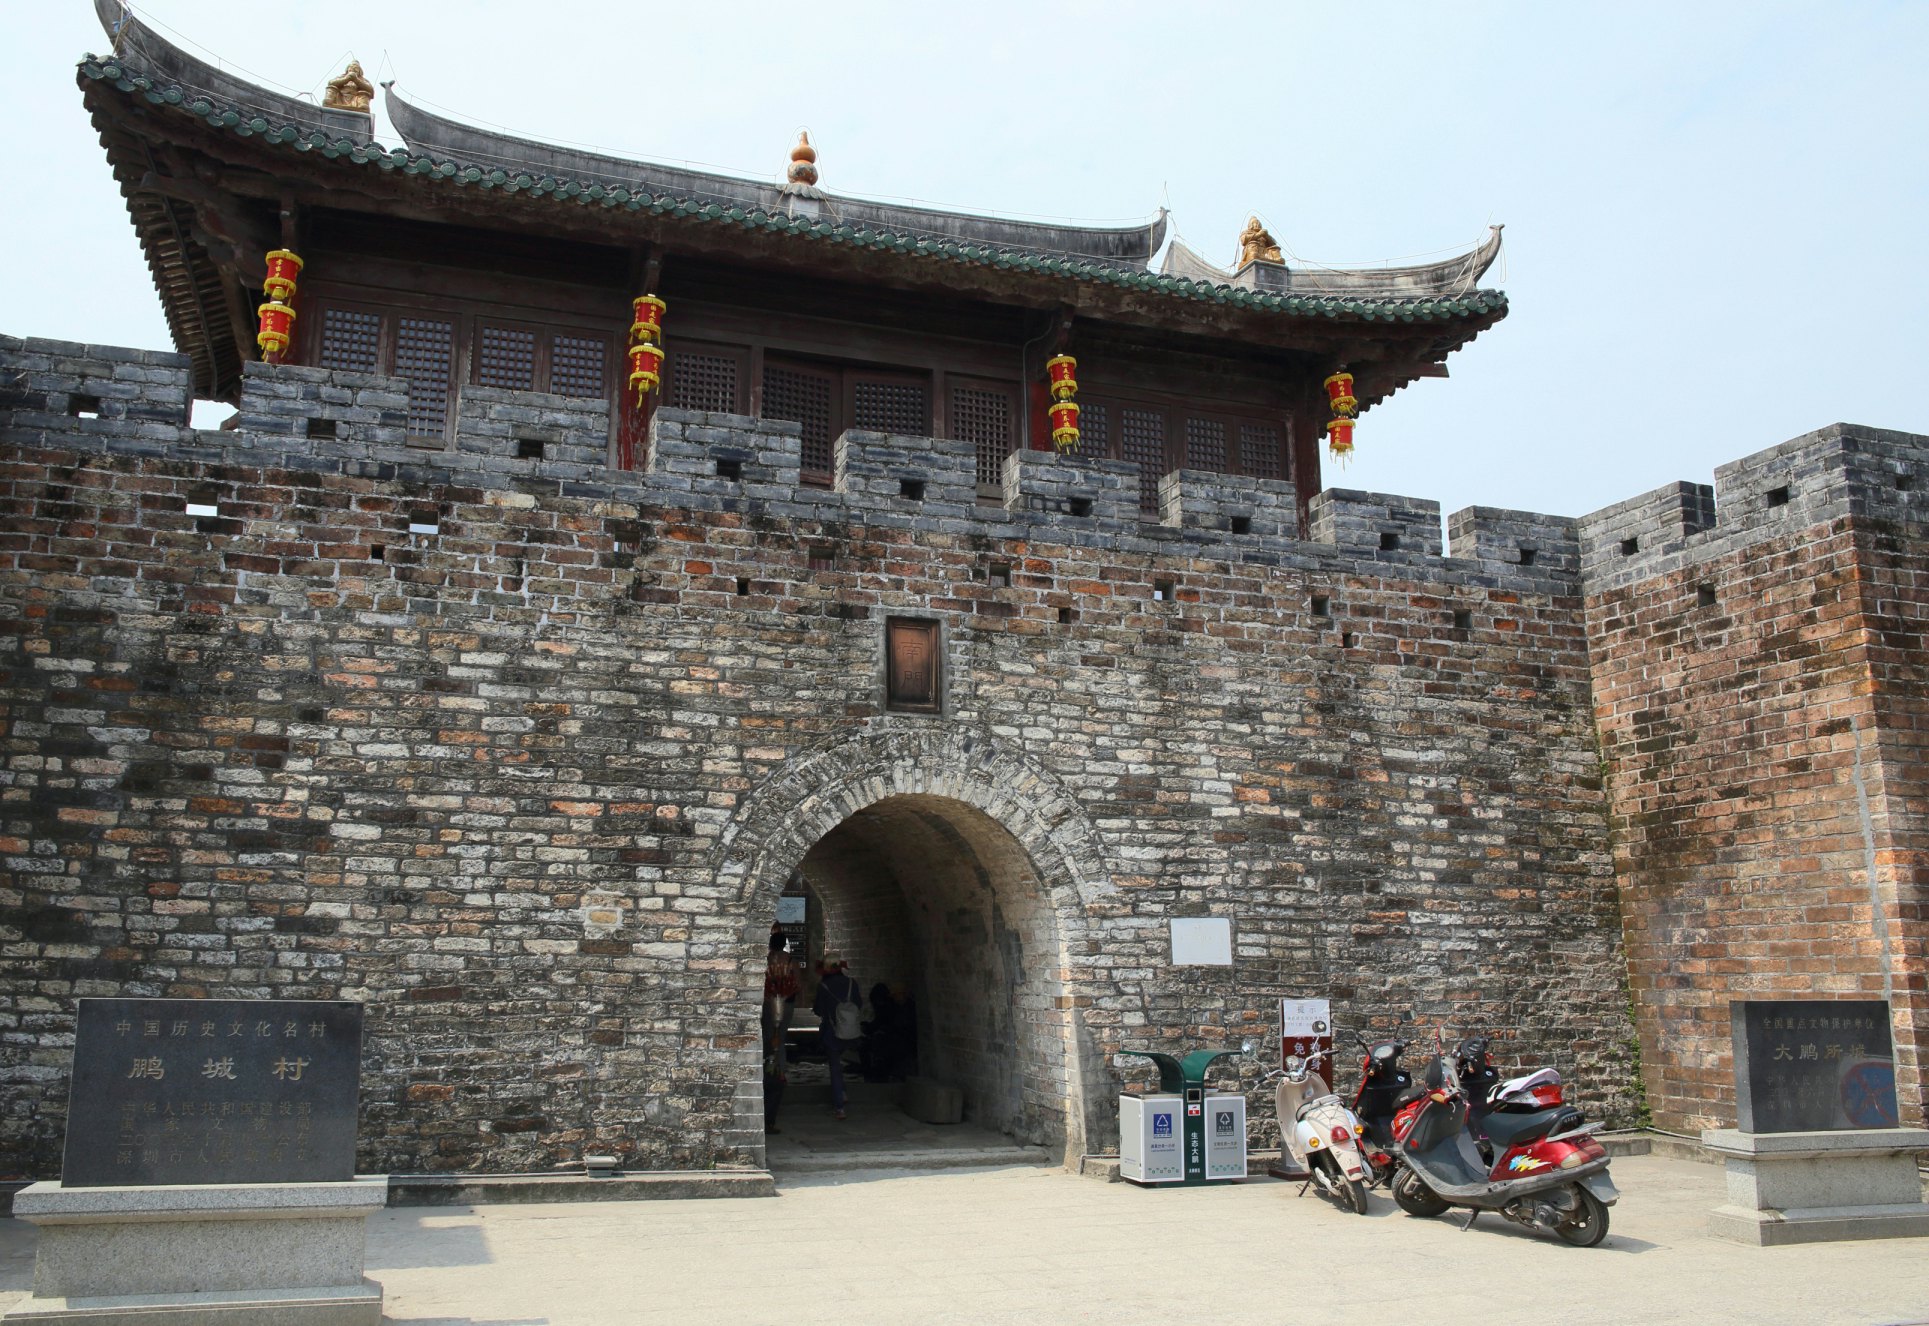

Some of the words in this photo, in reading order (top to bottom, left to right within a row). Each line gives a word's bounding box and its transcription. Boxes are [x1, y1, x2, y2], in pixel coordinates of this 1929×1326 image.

[116, 1019, 328, 1038] 中国历史文化名村
[1763, 1017, 1874, 1030] 全国重点文物保护单位
[1773, 1042, 1866, 1061] 大鹏所城
[127, 1055, 311, 1081] 鹏城村
[120, 1102, 312, 1116] 中华人民共和国建设部
